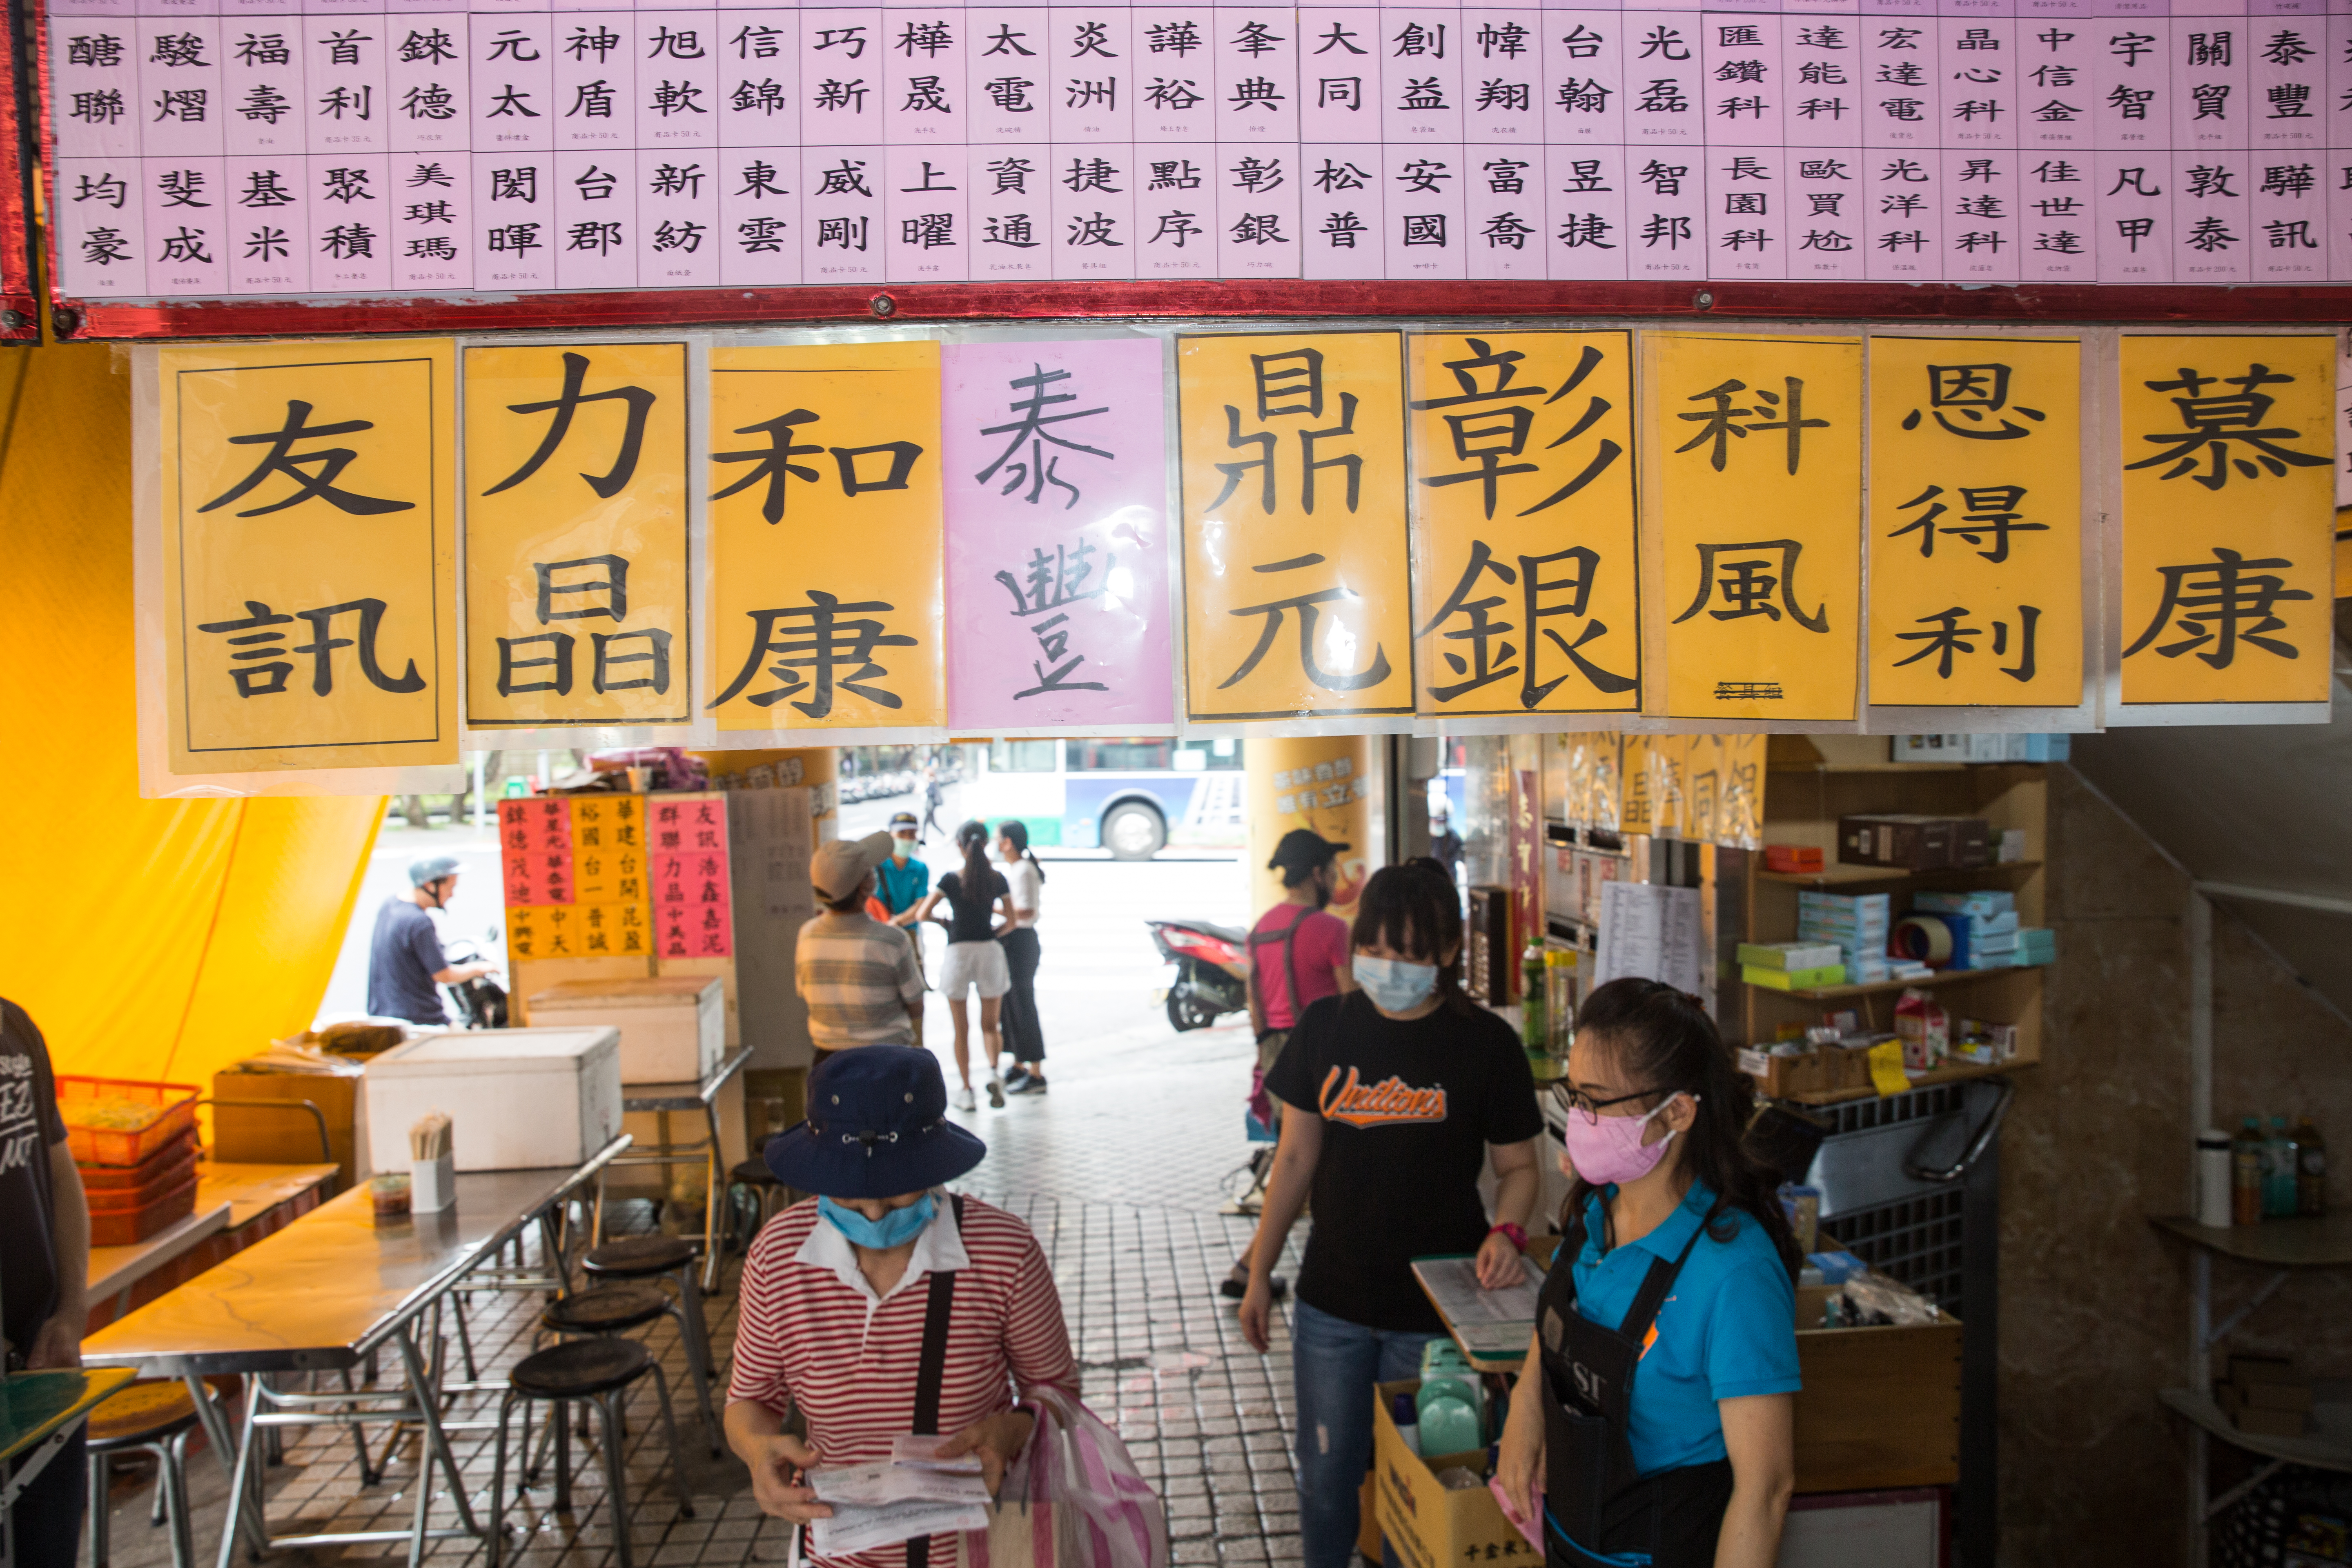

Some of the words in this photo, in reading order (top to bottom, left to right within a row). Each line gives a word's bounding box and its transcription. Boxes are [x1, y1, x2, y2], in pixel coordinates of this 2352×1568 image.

[68, 33, 125, 125] 醣聯
[150, 32, 211, 122] 駿熠
[235, 33, 291, 125] 福壽
[318, 29, 372, 120] 首利
[398, 28, 458, 120] 錸德
[486, 30, 541, 118] 元太
[564, 25, 620, 118] 神盾
[648, 26, 708, 117] 旭軟
[730, 25, 785, 116] 信錦
[813, 27, 870, 114] 巧新
[894, 20, 953, 113] 樺晟
[982, 23, 1036, 112] 太電
[1066, 21, 1118, 111] 炎洲
[1144, 20, 1205, 110] 譁裕
[1313, 22, 1368, 111] 大同
[1392, 22, 1450, 110] 創益
[1475, 22, 1530, 111] 幃翔
[1555, 24, 1613, 113] 台翰
[1635, 25, 1690, 113] 光磊
[1796, 25, 1849, 120] 達能科
[1875, 27, 1927, 121] 宏達電
[1953, 28, 2005, 122] 晶心科
[2029, 28, 2083, 122] 中信金
[2107, 32, 2156, 120] 宇智
[2188, 31, 2232, 120] 關貿
[2260, 30, 2316, 119] 泰豐
[73, 173, 133, 265] 均豪
[158, 169, 212, 263] 斐成
[238, 170, 296, 262] 基米
[321, 168, 376, 259] 聚積
[403, 163, 457, 261] 美琪瑪
[488, 167, 542, 259] 閎暉
[566, 165, 622, 257] 台郡
[650, 163, 706, 253] 新紡
[734, 160, 789, 253] 東雲
[815, 159, 872, 252] 威剛
[900, 162, 957, 250] 上曜
[982, 157, 1041, 248] 資通
[1062, 158, 1124, 246] 捷波
[1147, 160, 1203, 248] 點序
[1229, 156, 1290, 245] 彰銀
[1313, 158, 1372, 249] 松普
[1396, 159, 1452, 248] 安國
[1480, 158, 1536, 250] 富喬
[1557, 160, 1617, 249] 昱捷
[1639, 159, 1691, 250] 智邦
[1721, 157, 1774, 252] 長園科
[1799, 159, 1853, 252] 歐買尬
[1878, 159, 1930, 253] 光洋科
[1955, 159, 2007, 254] 昇達科
[2030, 160, 2085, 254] 佳世達
[2107, 167, 2161, 253] 凡甲
[2185, 165, 2239, 252] 敦泰
[2260, 163, 2318, 248] 驊訊
[989, 262, 1032, 271] 乳油木果皂
[1502, 262, 1512, 270] 米
[196, 399, 426, 699] 友訊
[481, 352, 673, 698] 力晶
[975, 362, 1117, 701] 泰豐
[1203, 347, 1392, 691] 鼎元
[1408, 338, 1637, 709] 彰銀
[1671, 376, 1830, 634] 科風
[1887, 363, 2051, 683] 恩得利
[2121, 363, 2335, 670] 慕康
[704, 408, 923, 719] 和康
[664, 857, 684, 903] 力晶
[549, 907, 570, 953] 中天
